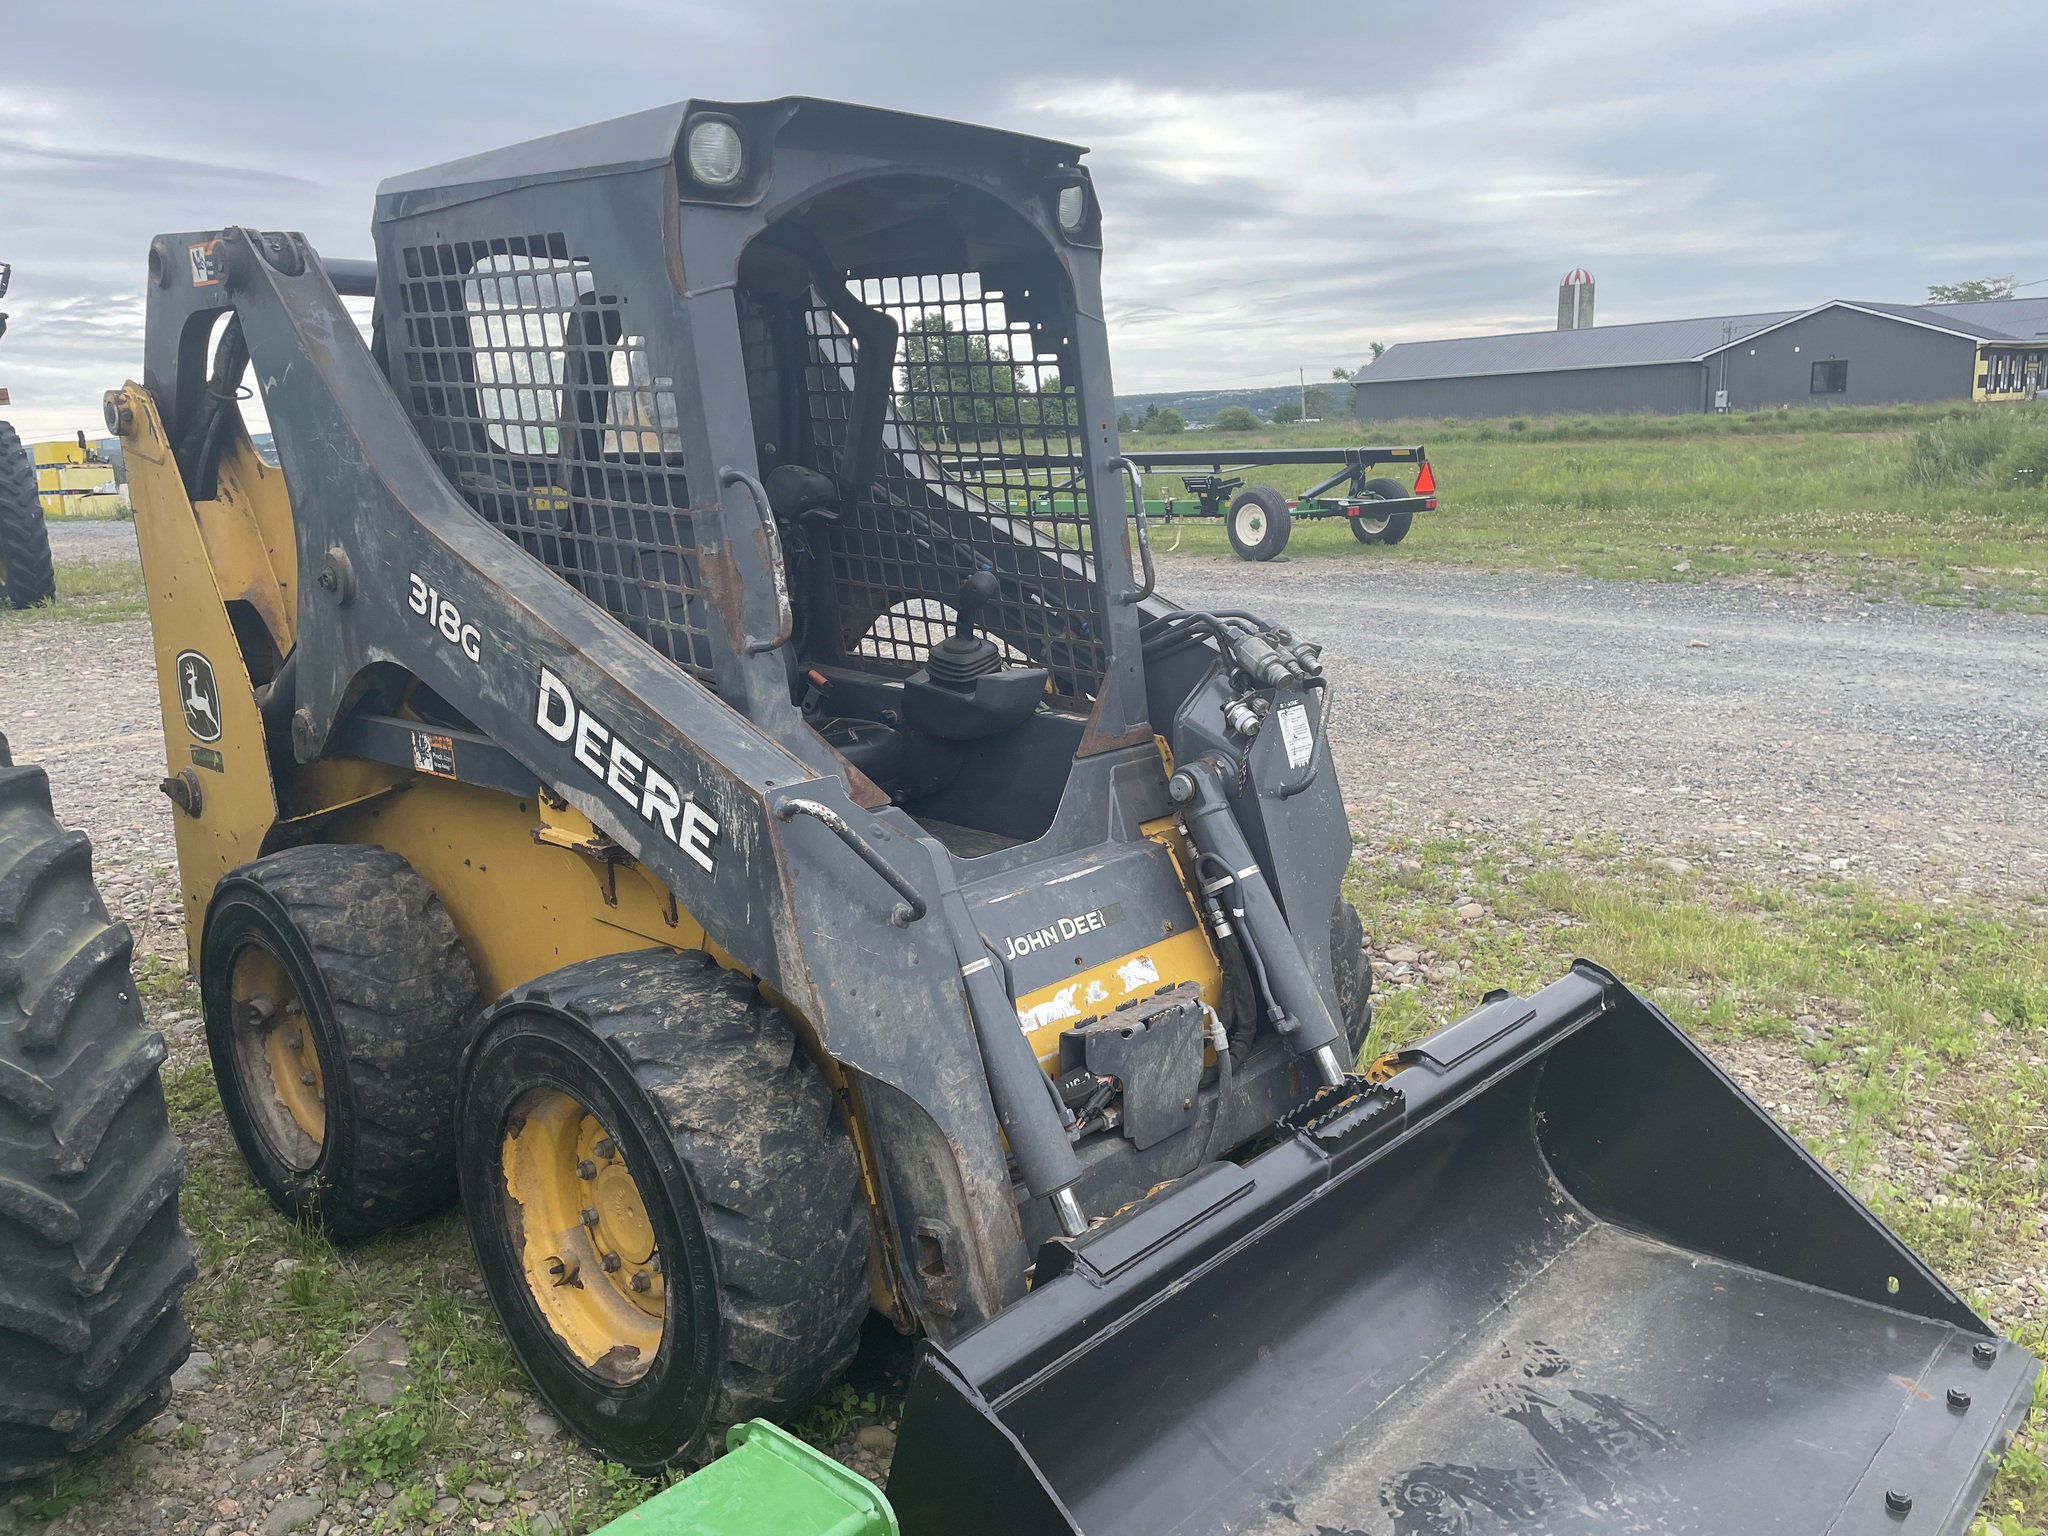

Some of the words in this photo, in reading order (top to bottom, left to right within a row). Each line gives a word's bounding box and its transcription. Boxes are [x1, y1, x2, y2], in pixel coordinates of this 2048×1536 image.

[408, 572, 482, 663] 318G
[536, 666, 720, 874] DEERE
[1005, 926, 1060, 961] JOHN
